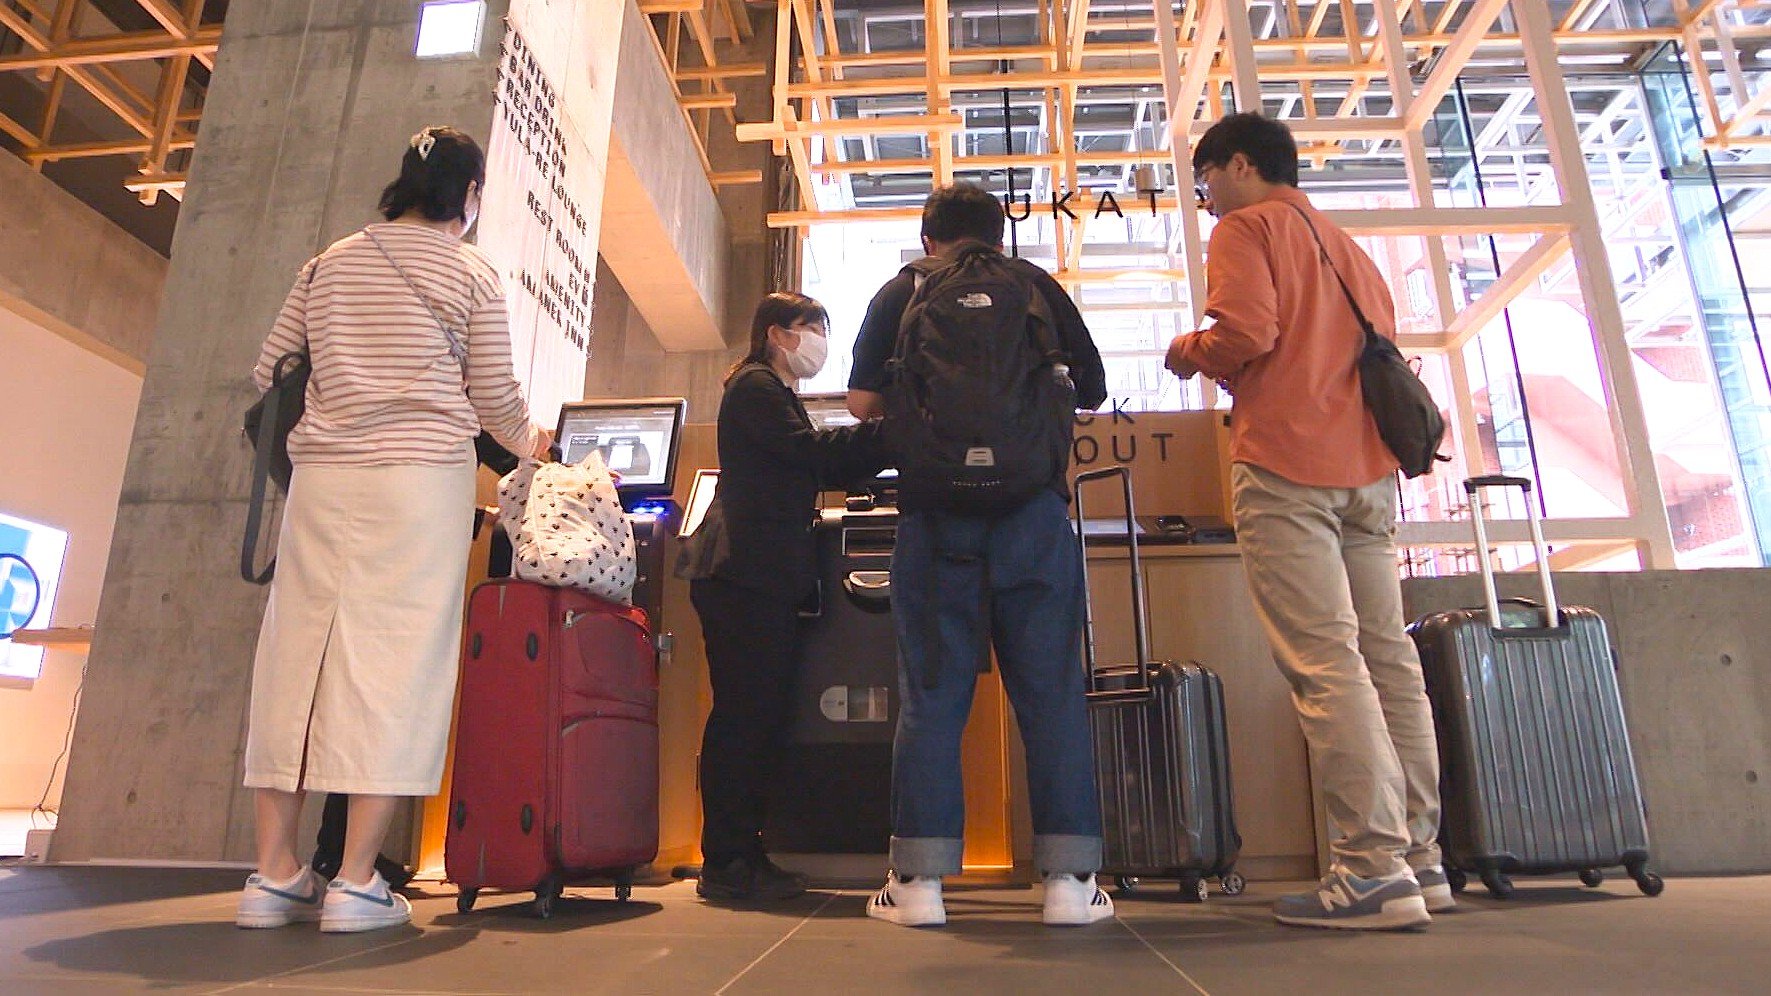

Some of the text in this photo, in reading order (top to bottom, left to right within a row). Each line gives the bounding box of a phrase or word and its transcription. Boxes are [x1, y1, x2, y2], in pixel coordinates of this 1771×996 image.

[510, 54, 531, 99] BAR
[514, 31, 555, 108] DINING
[506, 77, 566, 177] RECEPTION
[526, 189, 582, 274] REST ROOM
[551, 174, 587, 237] LOUNGE
[568, 271, 580, 296] EV
[1073, 432, 1174, 464] OUT
